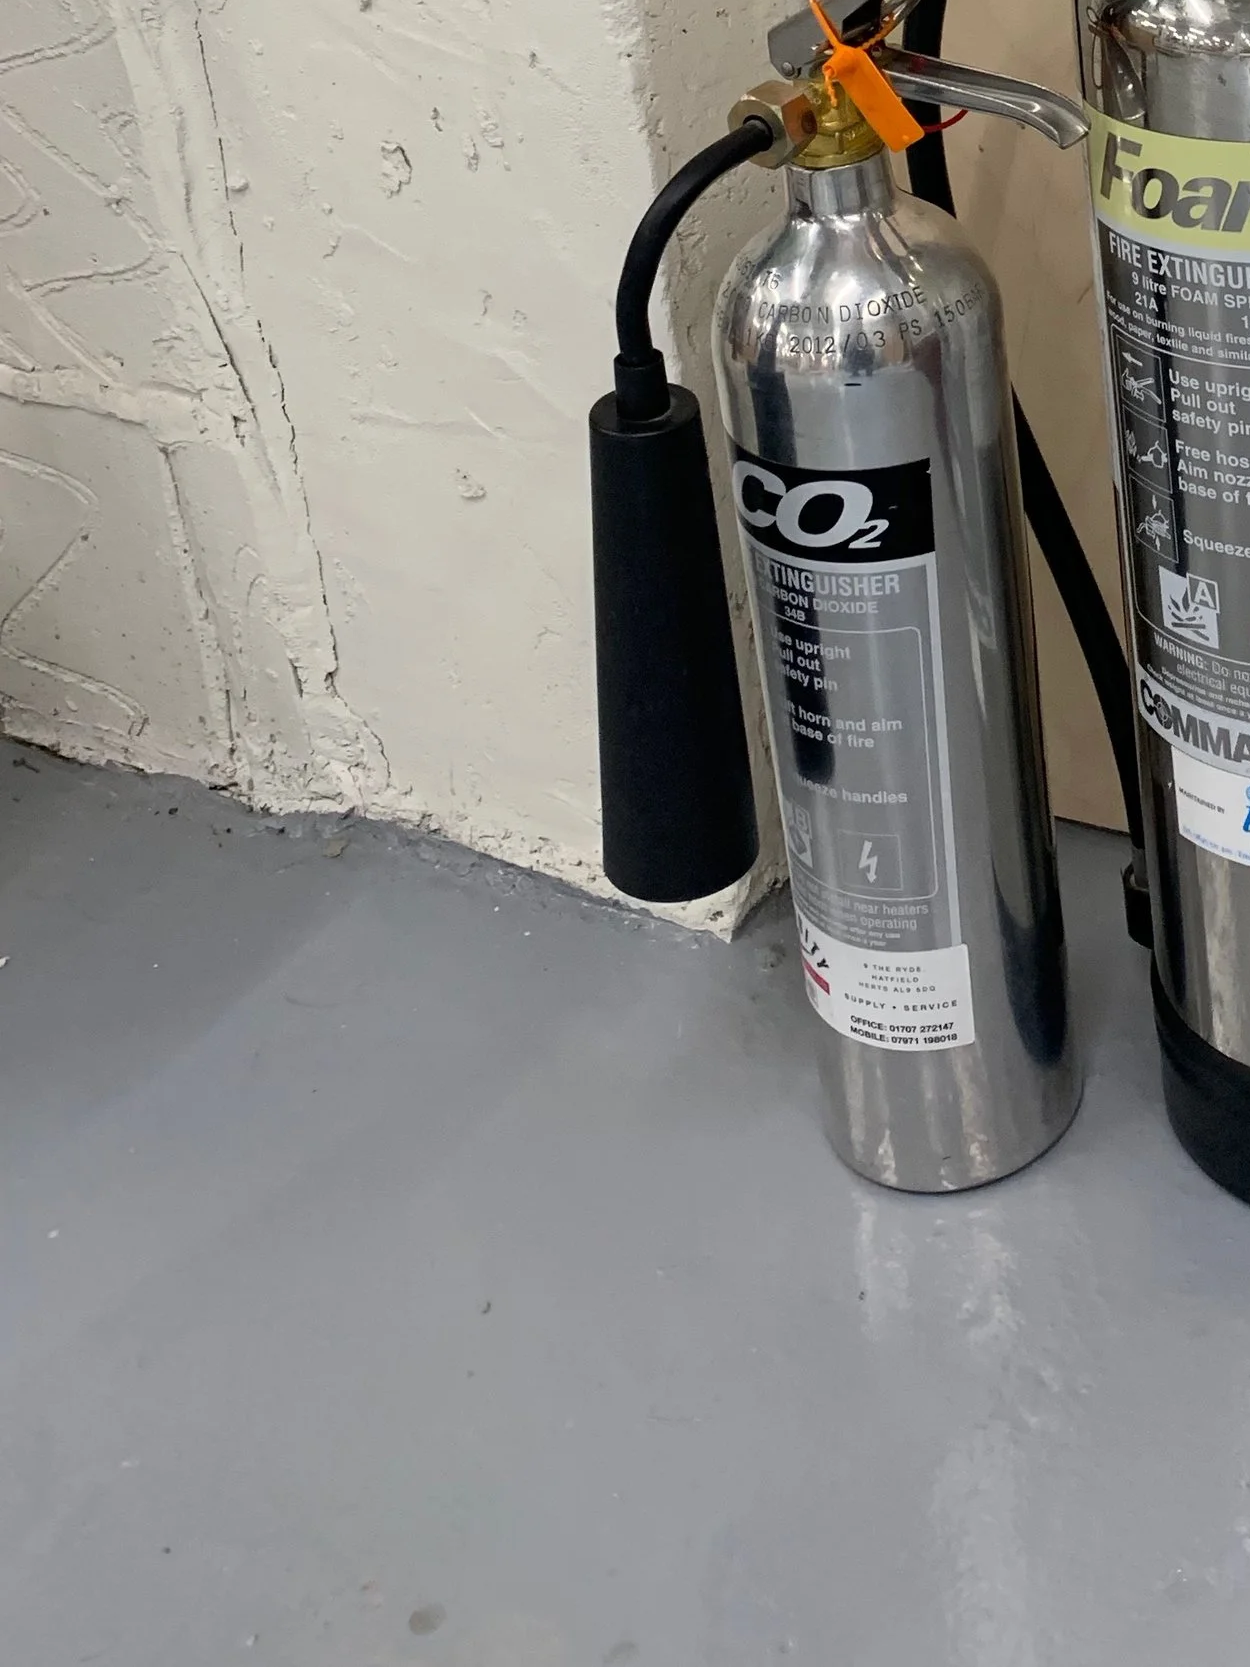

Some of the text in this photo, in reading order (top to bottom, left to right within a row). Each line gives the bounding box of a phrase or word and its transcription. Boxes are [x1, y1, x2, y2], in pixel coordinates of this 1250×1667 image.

[1108, 231, 1142, 270] FIRE
[1131, 271, 1140, 286] 9
[1142, 276, 1167, 295] litre
[1170, 284, 1219, 306] FOAM
[839, 285, 928, 323] DIOXIDE
[1134, 291, 1159, 312] 21A
[1132, 309, 1144, 321] on
[1145, 314, 1185, 338] burning
[1188, 326, 1222, 342] liquid
[1156, 333, 1189, 351] textile
[1191, 344, 1214, 357] and
[1168, 368, 1200, 390] Use
[1170, 389, 1237, 416] Pull out
[1172, 408, 1222, 434] safety
[1175, 439, 1211, 462] Free
[1176, 458, 1208, 480] Aim
[1178, 477, 1217, 500] base
[1222, 490, 1241, 504] of
[755, 552, 901, 596] EXTINGUISHER
[1193, 581, 1216, 608] A
[784, 605, 806, 622] 34B
[812, 598, 879, 615] DIOXIDE
[794, 638, 851, 661] upright
[1153, 631, 1208, 671] WARNING:
[1211, 660, 1229, 677] Do
[796, 654, 821, 672] out
[813, 676, 838, 693] pin
[1176, 663, 1226, 690] electrical
[798, 705, 831, 728] horn
[834, 719, 866, 732] and
[871, 718, 903, 732] aim
[791, 717, 824, 741] base
[826, 733, 843, 746] of
[847, 735, 875, 748] fire
[842, 787, 909, 804] handles
[853, 901, 882, 915] near
[883, 903, 929, 917] heaters
[860, 916, 918, 931] operating
[871, 974, 919, 983] HATFIELD
[873, 964, 891, 972] THE
[859, 981, 889, 993] HERTS
[844, 993, 958, 1012] SUPPLY SERVICE
[850, 1015, 954, 1034] OFFICE: 01707 272147
[850, 1025, 958, 1045] MOBILE: 07971 198018
